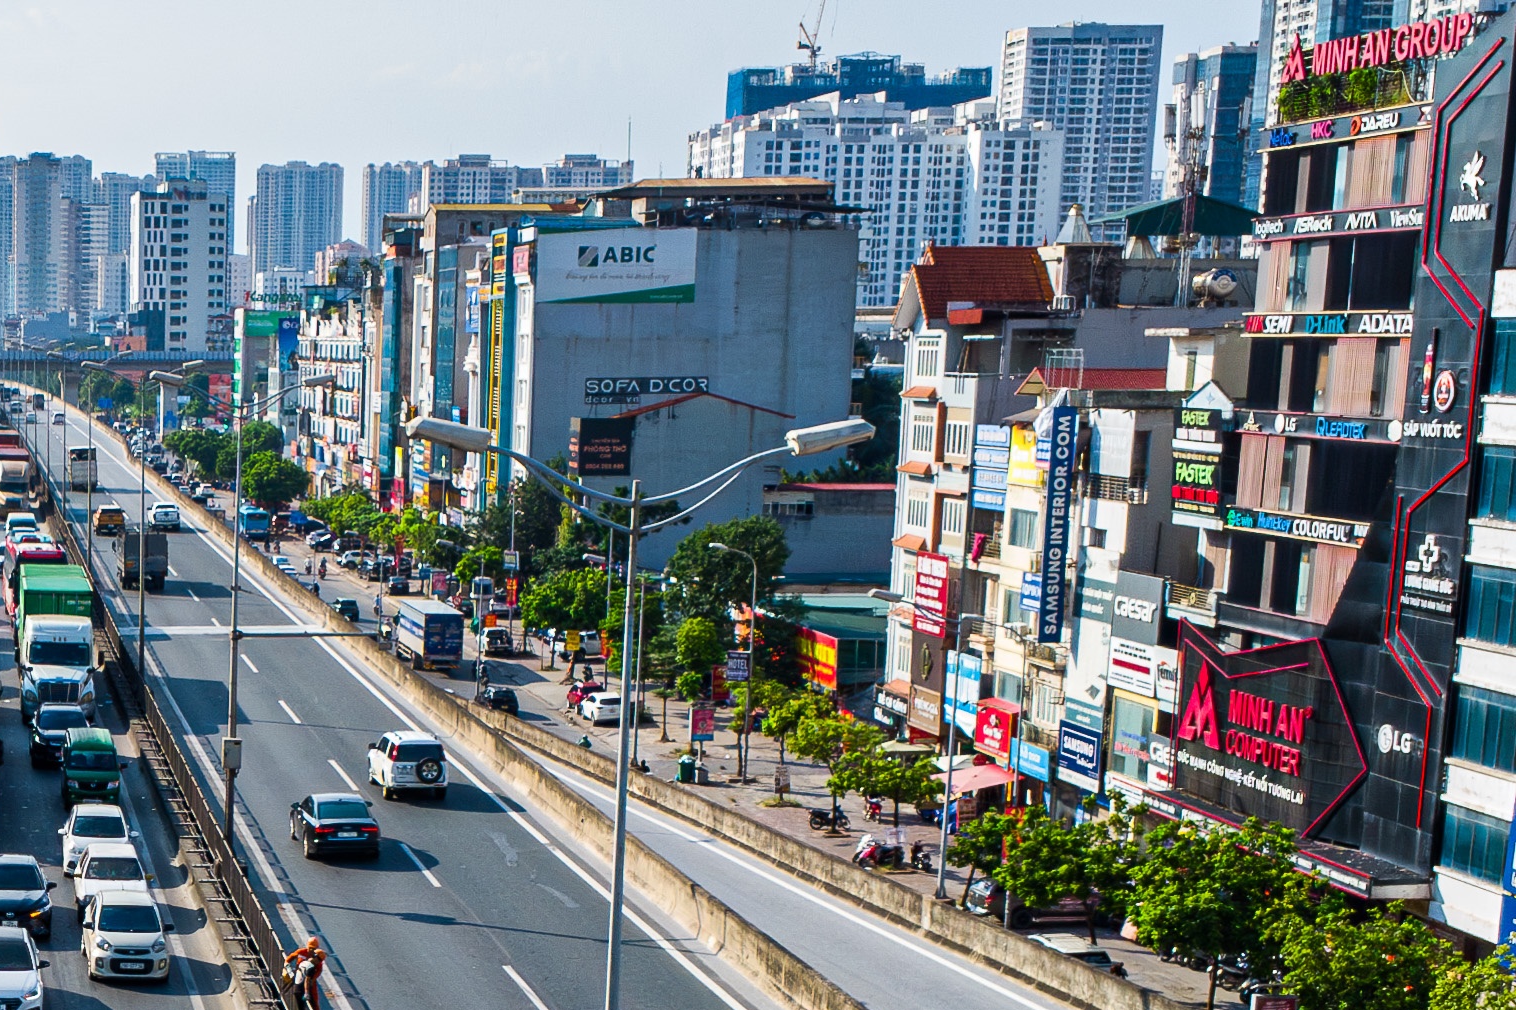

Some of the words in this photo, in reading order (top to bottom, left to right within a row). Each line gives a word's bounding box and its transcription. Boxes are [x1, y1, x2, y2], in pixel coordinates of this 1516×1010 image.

[1312, 35, 1361, 76] MINH
[1361, 28, 1391, 68] AN
[1394, 13, 1473, 62] GROUP
[1311, 120, 1333, 140] HKC
[1360, 112, 1399, 132] DAREU
[1344, 211, 1377, 231] AVITA
[1449, 204, 1488, 222] AKUMA
[1254, 218, 1284, 239] logitech
[602, 246, 655, 263] ABIC
[1245, 315, 1293, 334] HIKSEMI
[1304, 314, 1347, 334] D-Link
[1357, 313, 1414, 334] ADATA
[586, 379, 640, 394] SOFA
[649, 378, 708, 393] D'COR
[1285, 416, 1297, 432] LG
[1175, 461, 1216, 485] FASTER
[1292, 518, 1348, 542] COLORFUL
[1044, 546, 1064, 635] SAMSUNG
[727, 658, 748, 669] HOTEL
[1227, 688, 1275, 735] MINH
[1275, 703, 1305, 745] AN
[1063, 735, 1094, 757] SAMSUNG
[1225, 728, 1301, 777] COMPUTER
